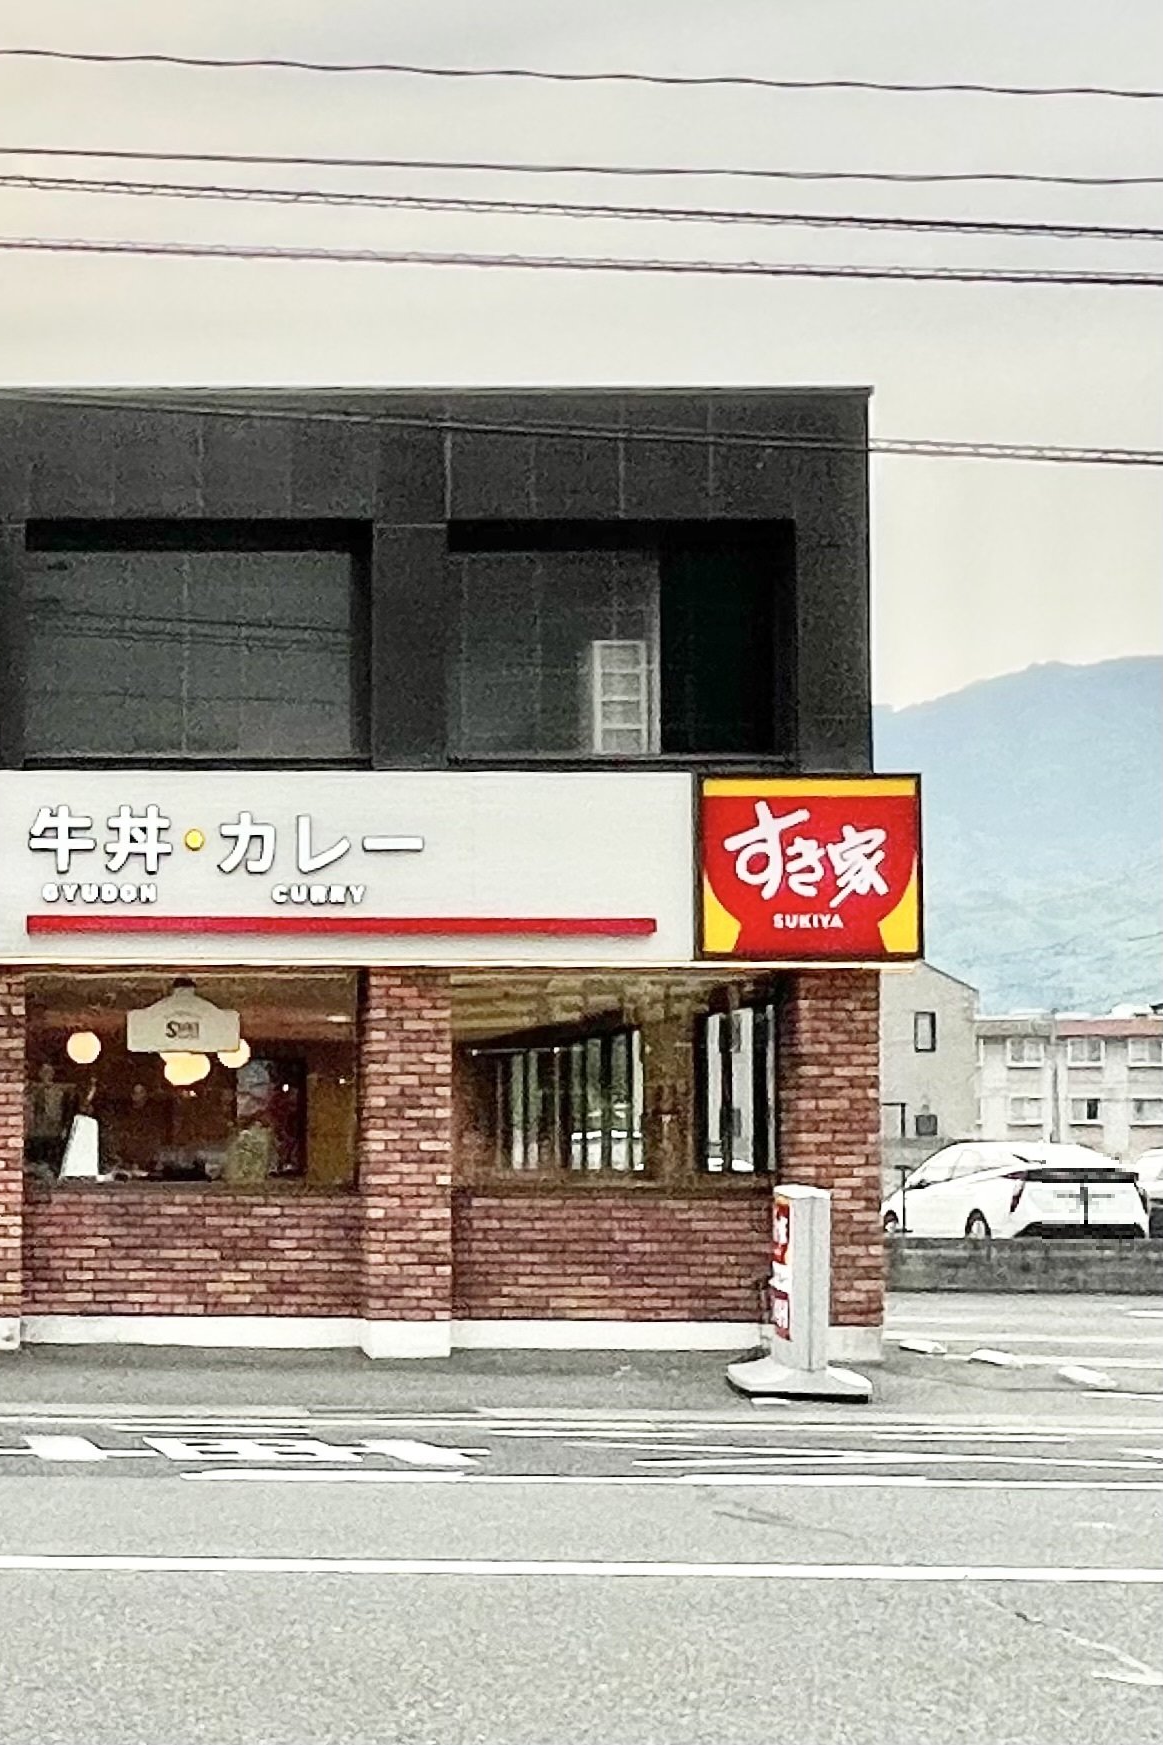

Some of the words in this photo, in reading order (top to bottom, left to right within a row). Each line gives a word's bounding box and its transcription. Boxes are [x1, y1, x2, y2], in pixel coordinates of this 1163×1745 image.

[723, 800, 889, 908] すき家
[41, 883, 159, 904] GYUDON
[270, 884, 367, 905] CURRY
[772, 913, 845, 930] SUKIYA
